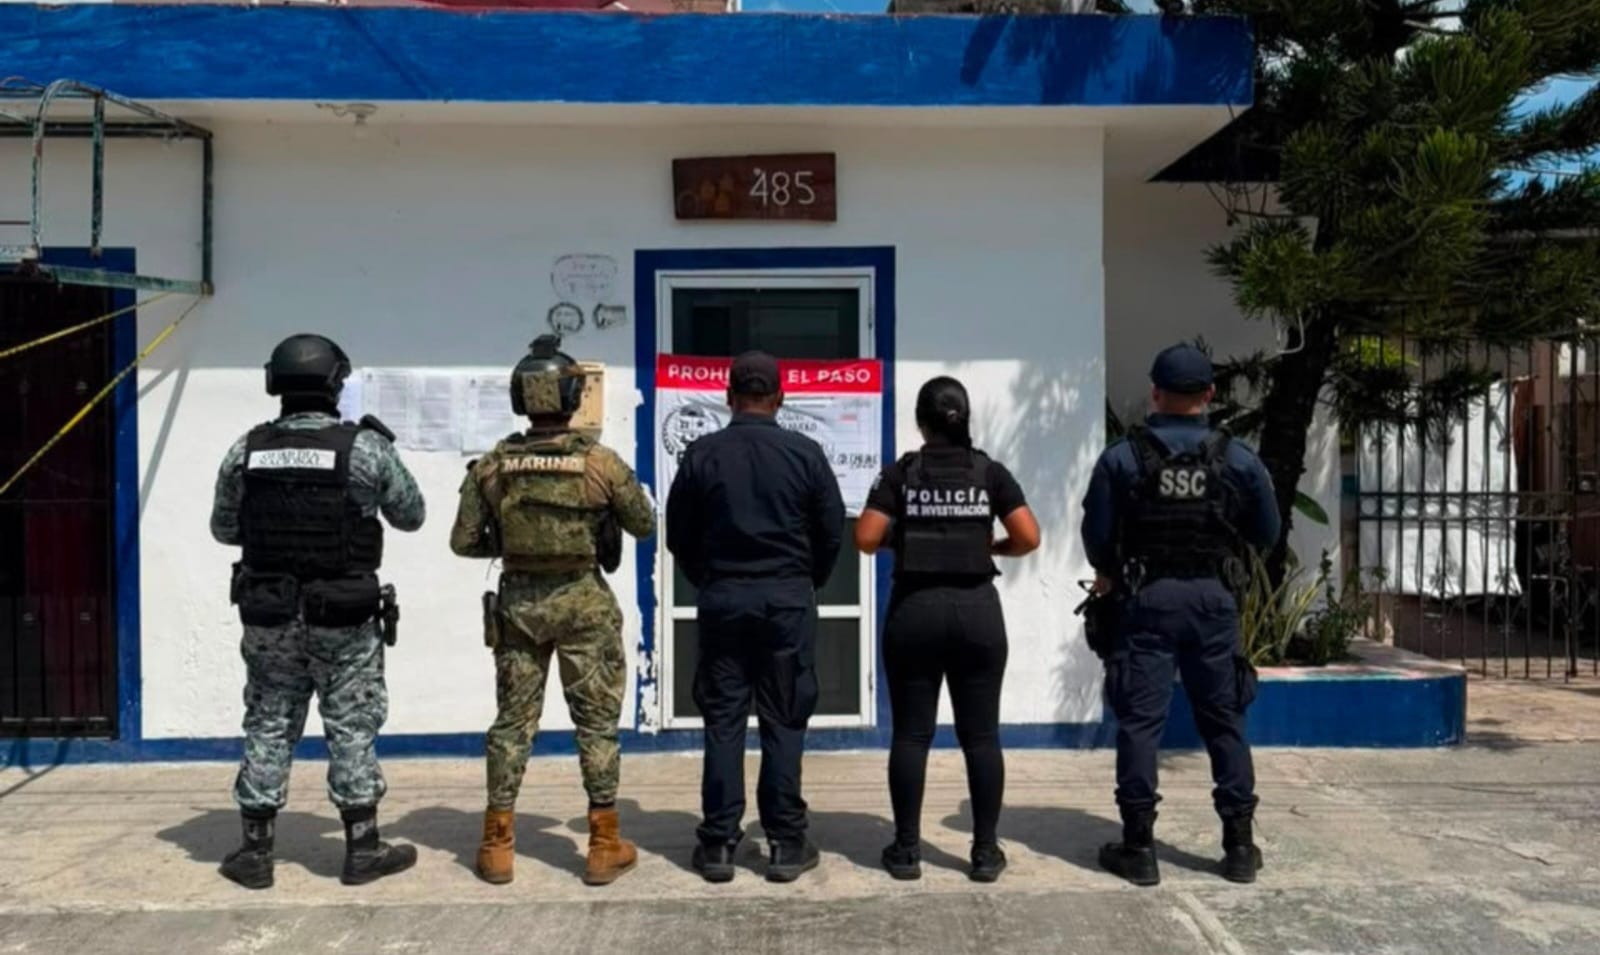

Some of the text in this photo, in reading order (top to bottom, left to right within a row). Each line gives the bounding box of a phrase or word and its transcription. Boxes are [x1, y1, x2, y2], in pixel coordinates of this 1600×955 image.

[750, 168, 815, 206] 485
[668, 364, 871, 386] PROHI EL PASO
[1159, 469, 1206, 496] SSC
[907, 487, 989, 503] POLICÍA
[906, 504, 919, 515] DE
